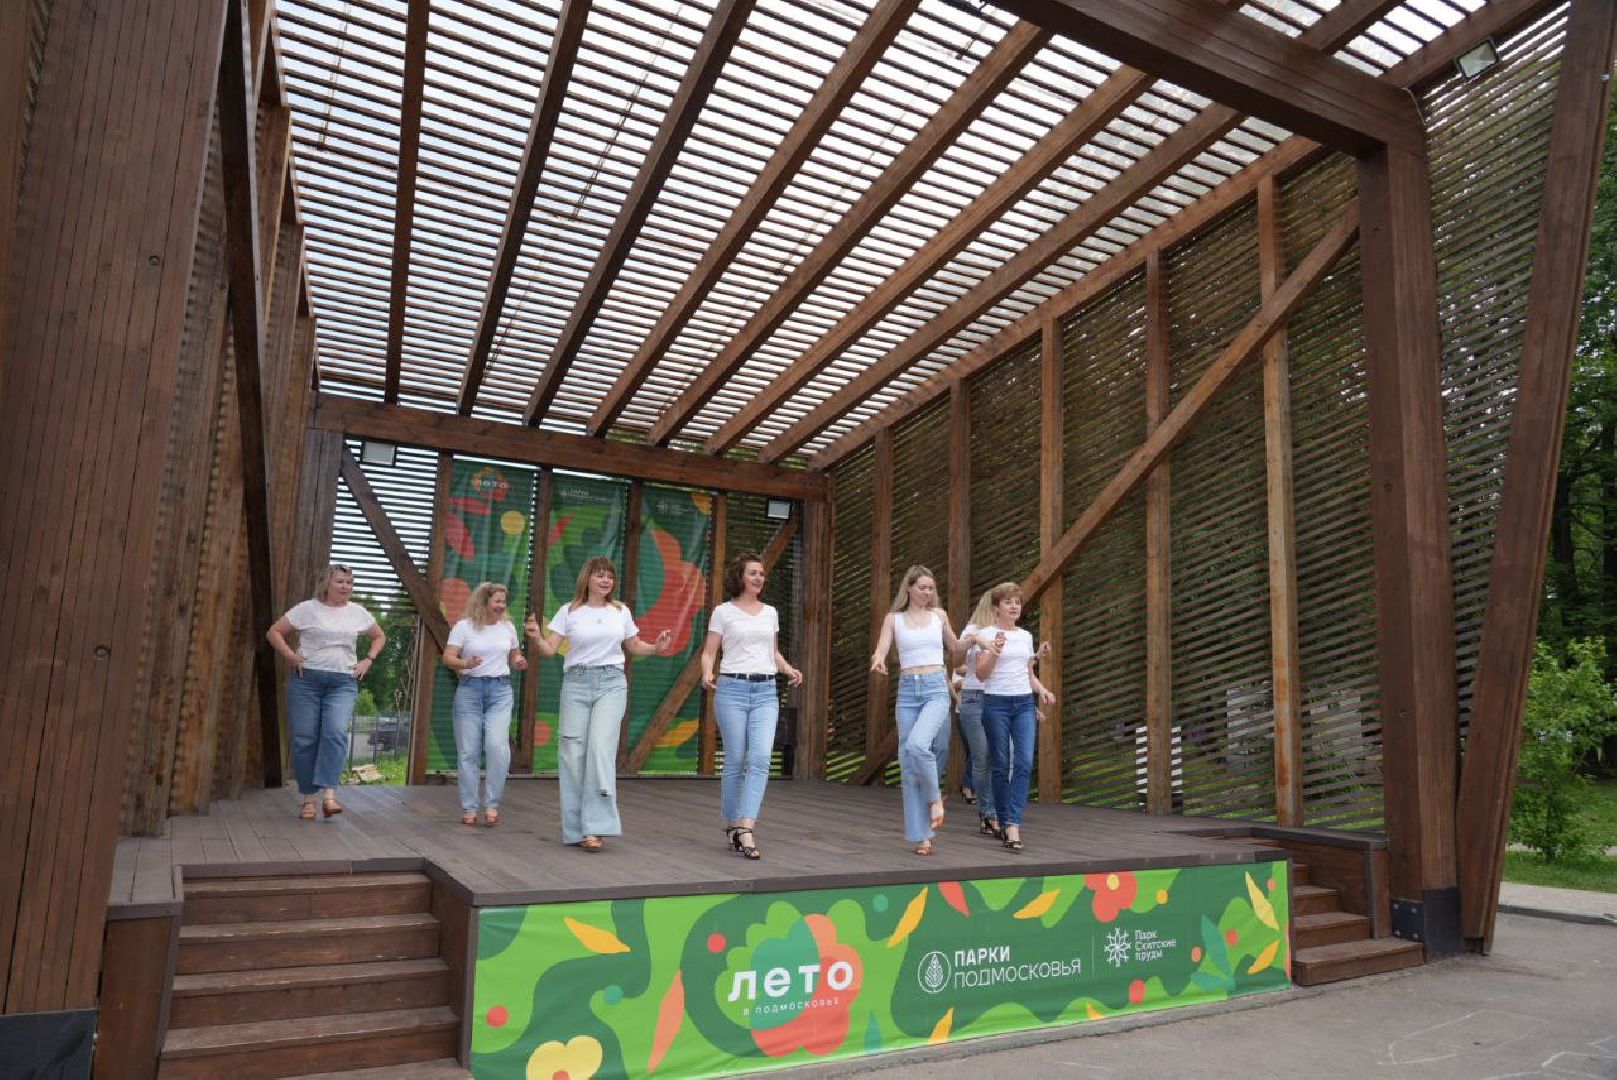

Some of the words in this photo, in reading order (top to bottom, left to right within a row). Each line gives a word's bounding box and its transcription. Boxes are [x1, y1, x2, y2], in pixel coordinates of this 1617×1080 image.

[954, 945, 1011, 967] ПАРКИ
[1134, 950, 1163, 962] пруды
[728, 961, 853, 1002] лето
[954, 957, 1082, 989] ПОДМОСКОВЬЯ
